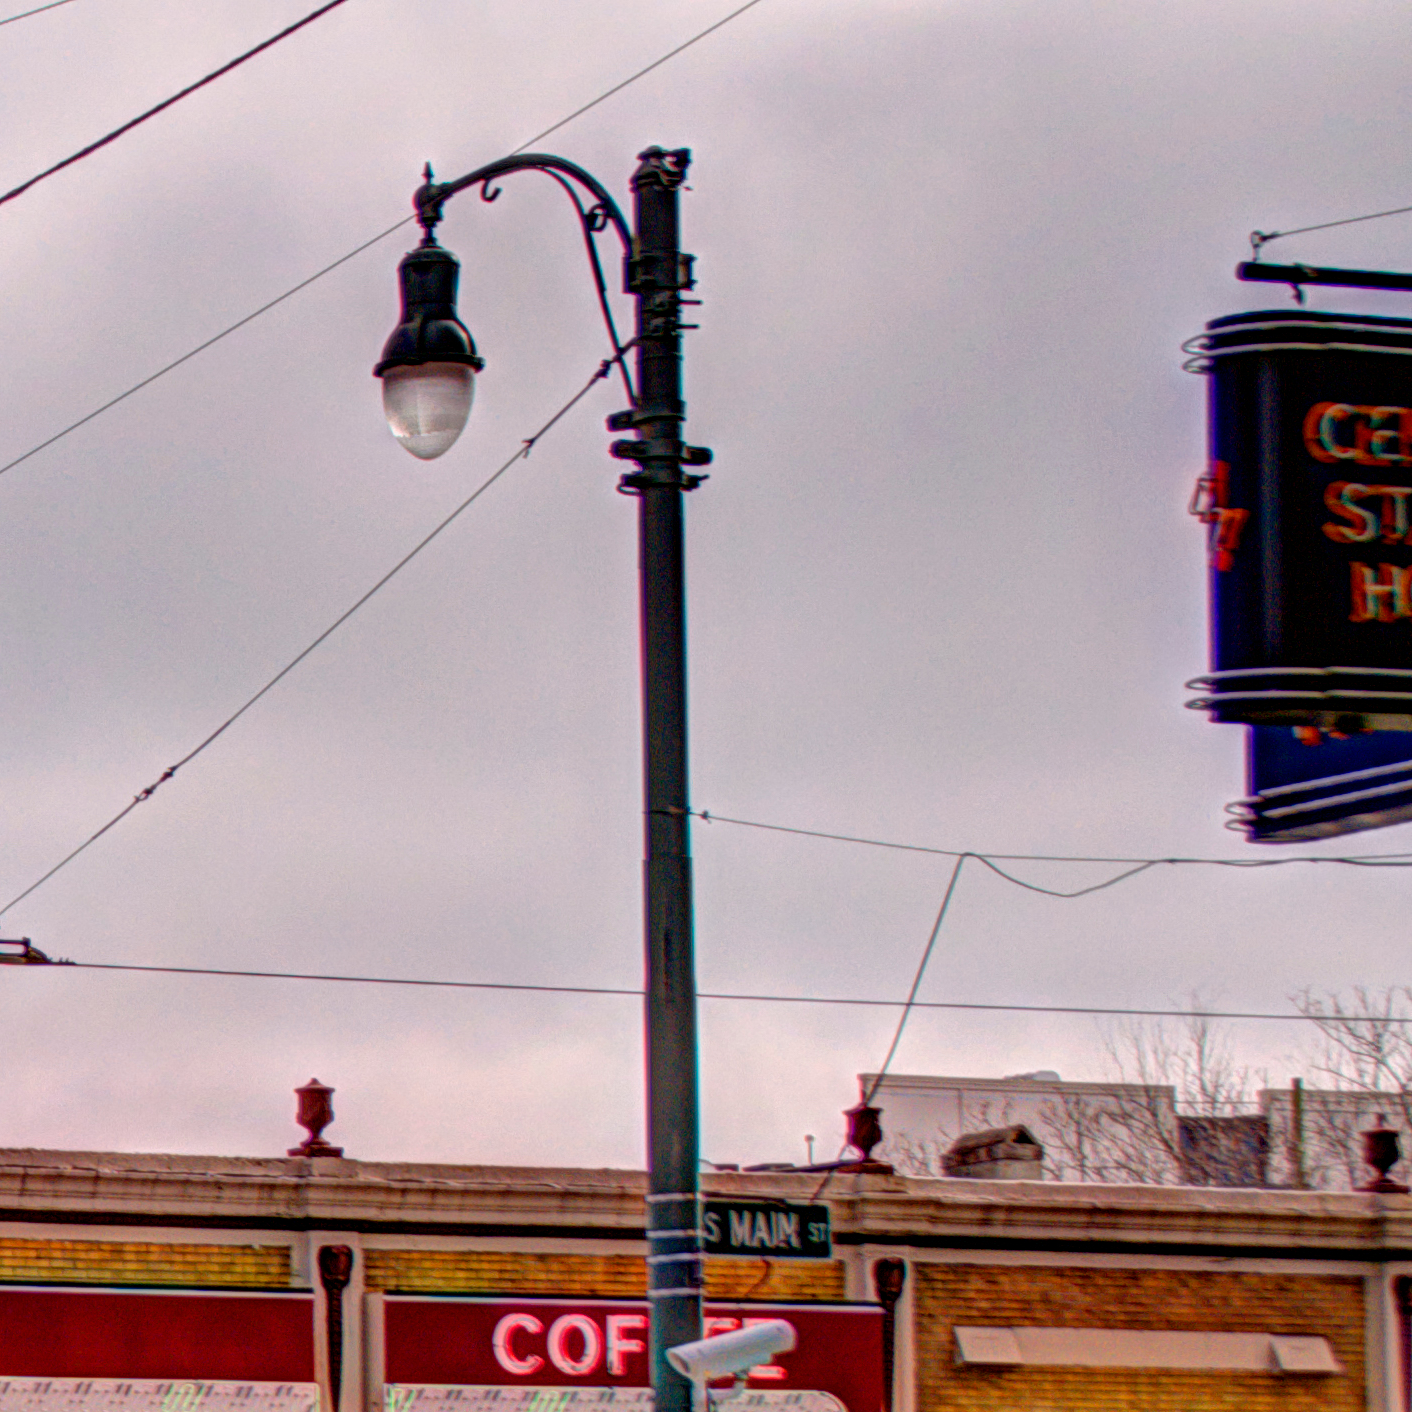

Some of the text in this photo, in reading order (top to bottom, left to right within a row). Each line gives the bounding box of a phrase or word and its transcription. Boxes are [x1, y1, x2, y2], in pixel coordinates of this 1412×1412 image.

[1303, 402, 1412, 466] CE
[1322, 481, 1412, 544] ST
[1349, 560, 1412, 622] H
[703, 1209, 827, 1250] S MAIN ST
